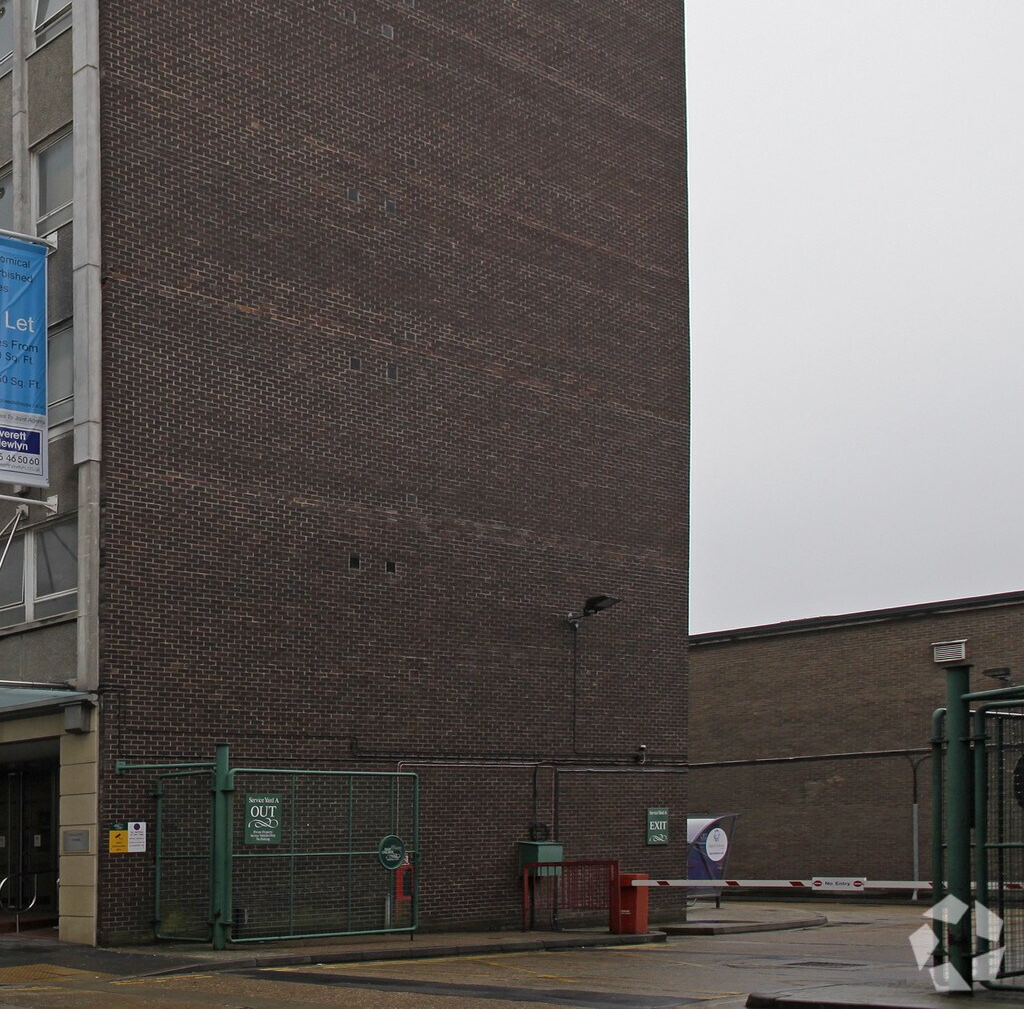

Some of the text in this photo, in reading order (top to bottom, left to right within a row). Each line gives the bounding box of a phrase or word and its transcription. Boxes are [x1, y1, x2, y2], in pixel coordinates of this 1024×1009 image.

[5, 310, 35, 333] Let
[11, 340, 39, 353] From
[250, 805, 277, 818] OUT
[649, 821, 668, 830] EXIT
